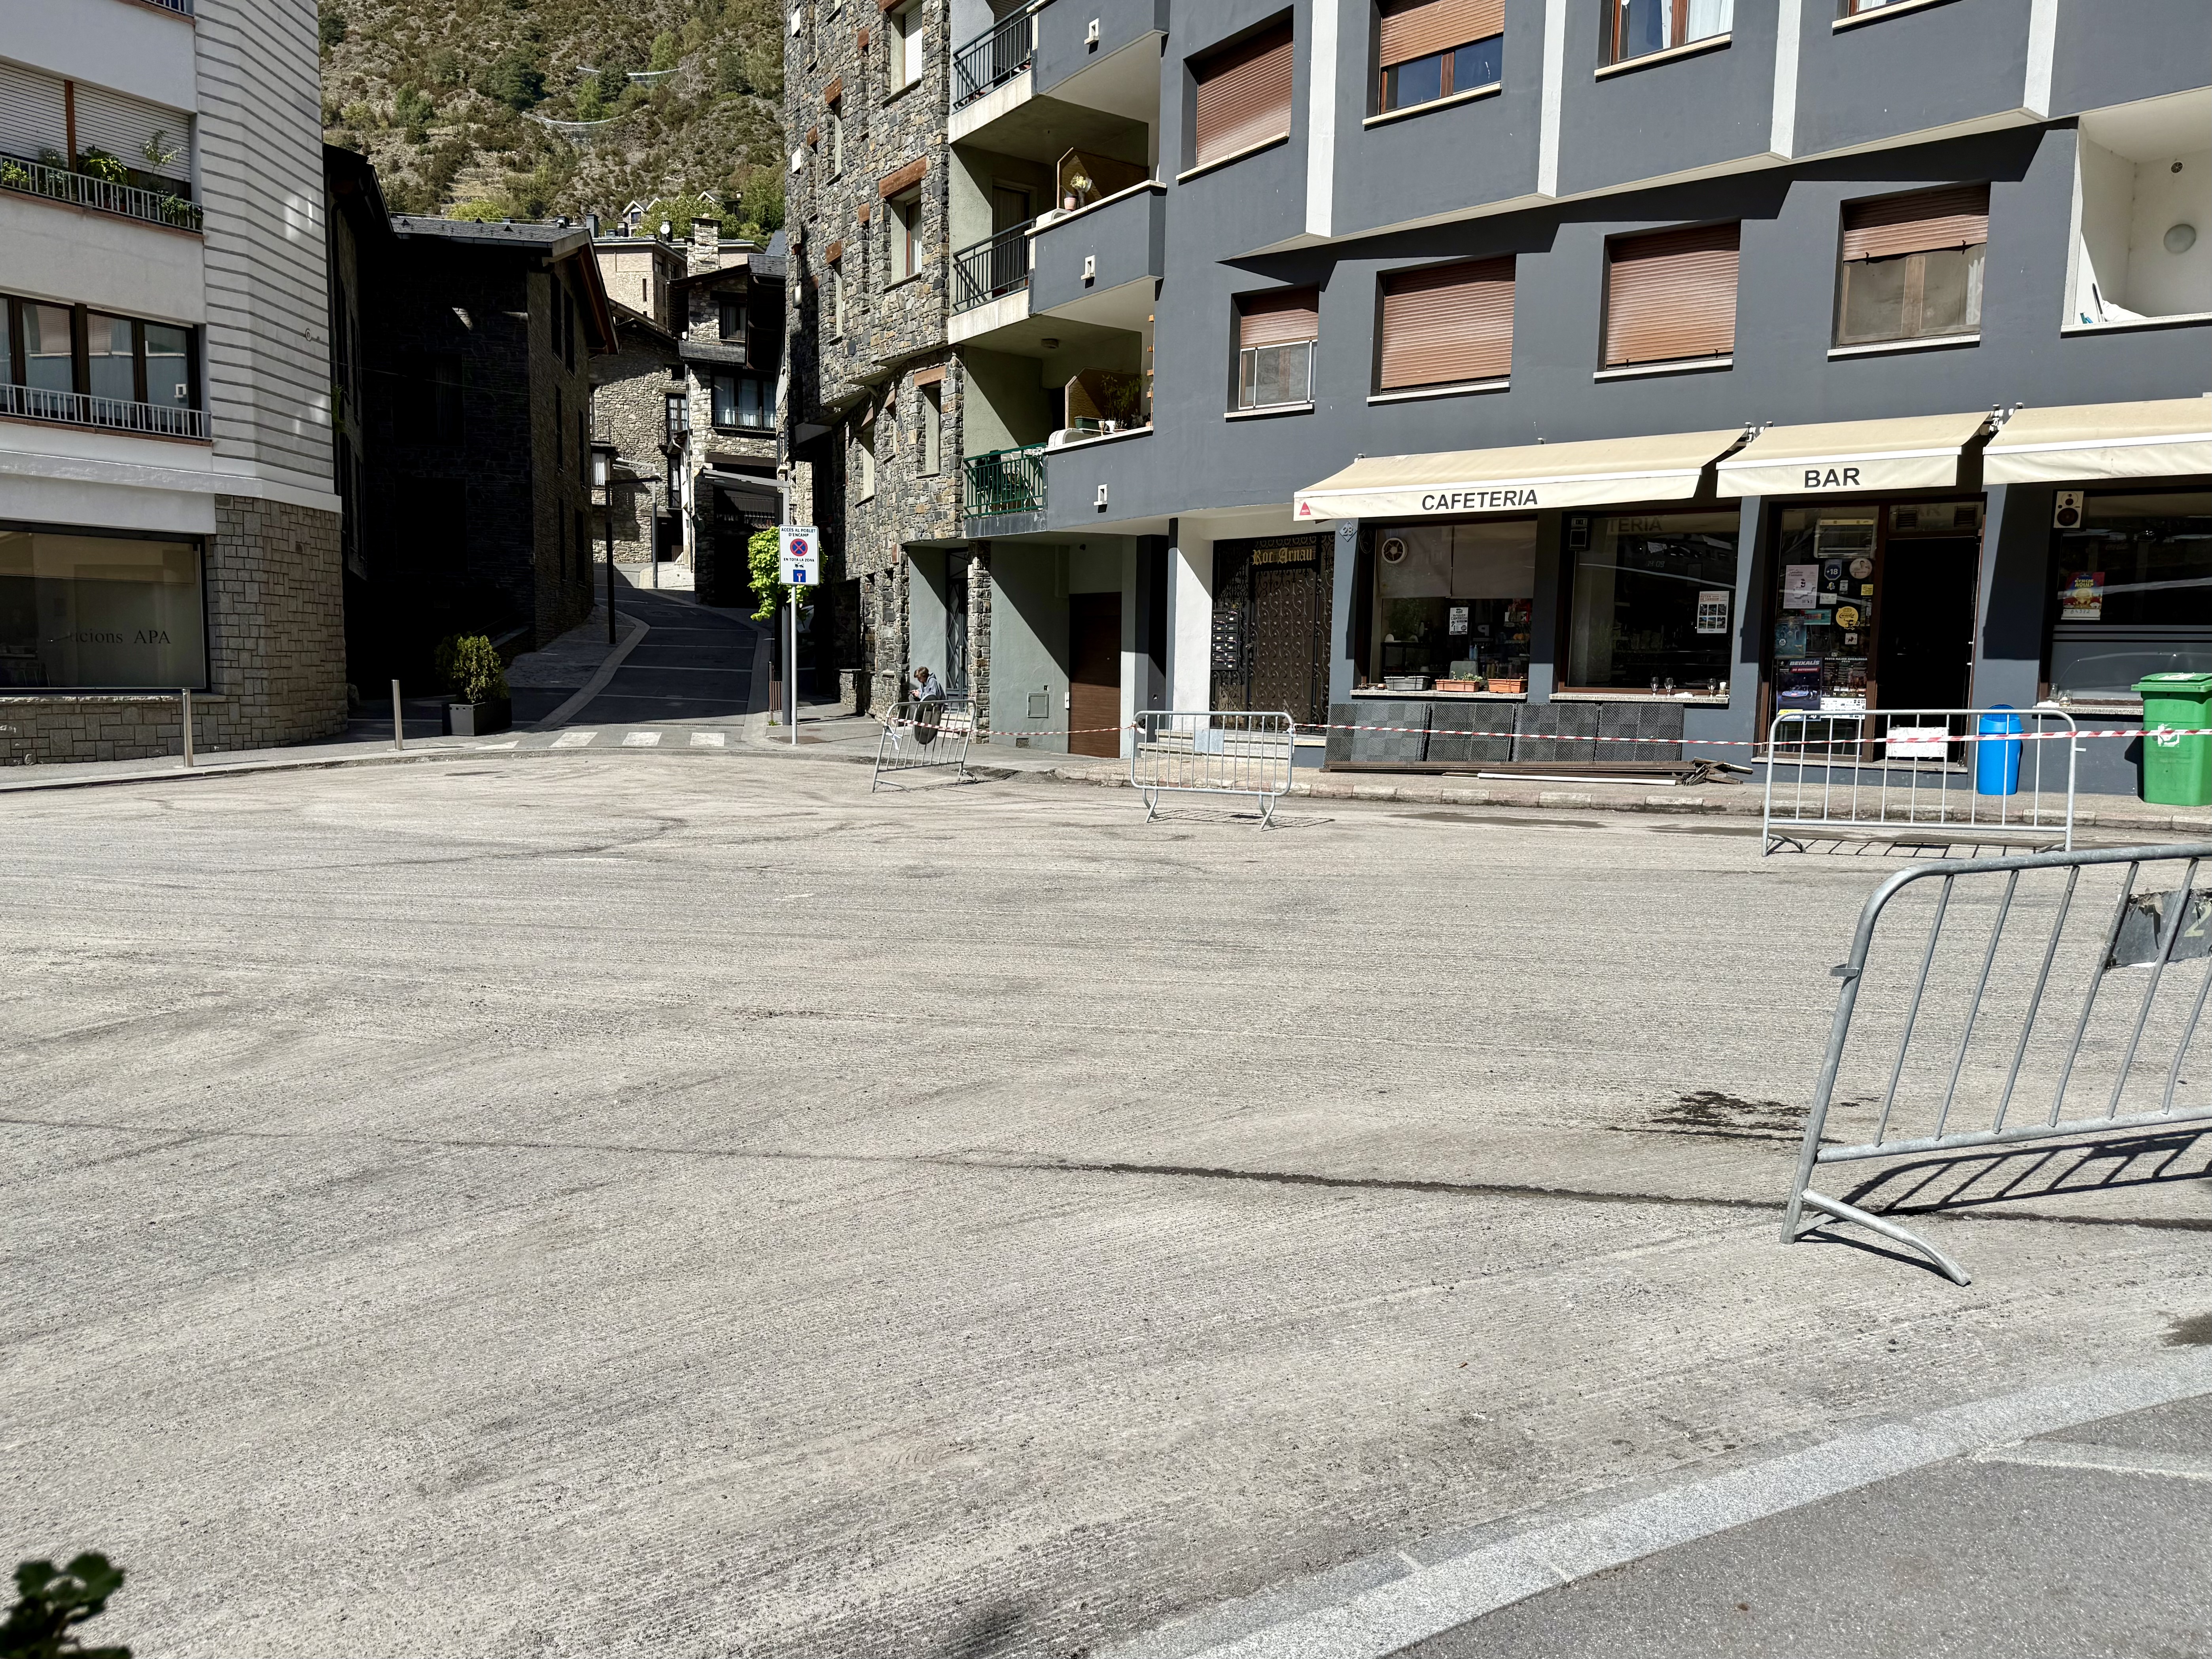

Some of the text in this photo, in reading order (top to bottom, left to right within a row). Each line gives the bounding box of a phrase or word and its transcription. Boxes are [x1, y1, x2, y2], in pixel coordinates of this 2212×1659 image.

[1805, 467, 1860, 488] BAR
[1422, 490, 1538, 510] CAFETERIA
[1277, 547, 1312, 564] Arnau
[134, 630, 171, 644] APA
